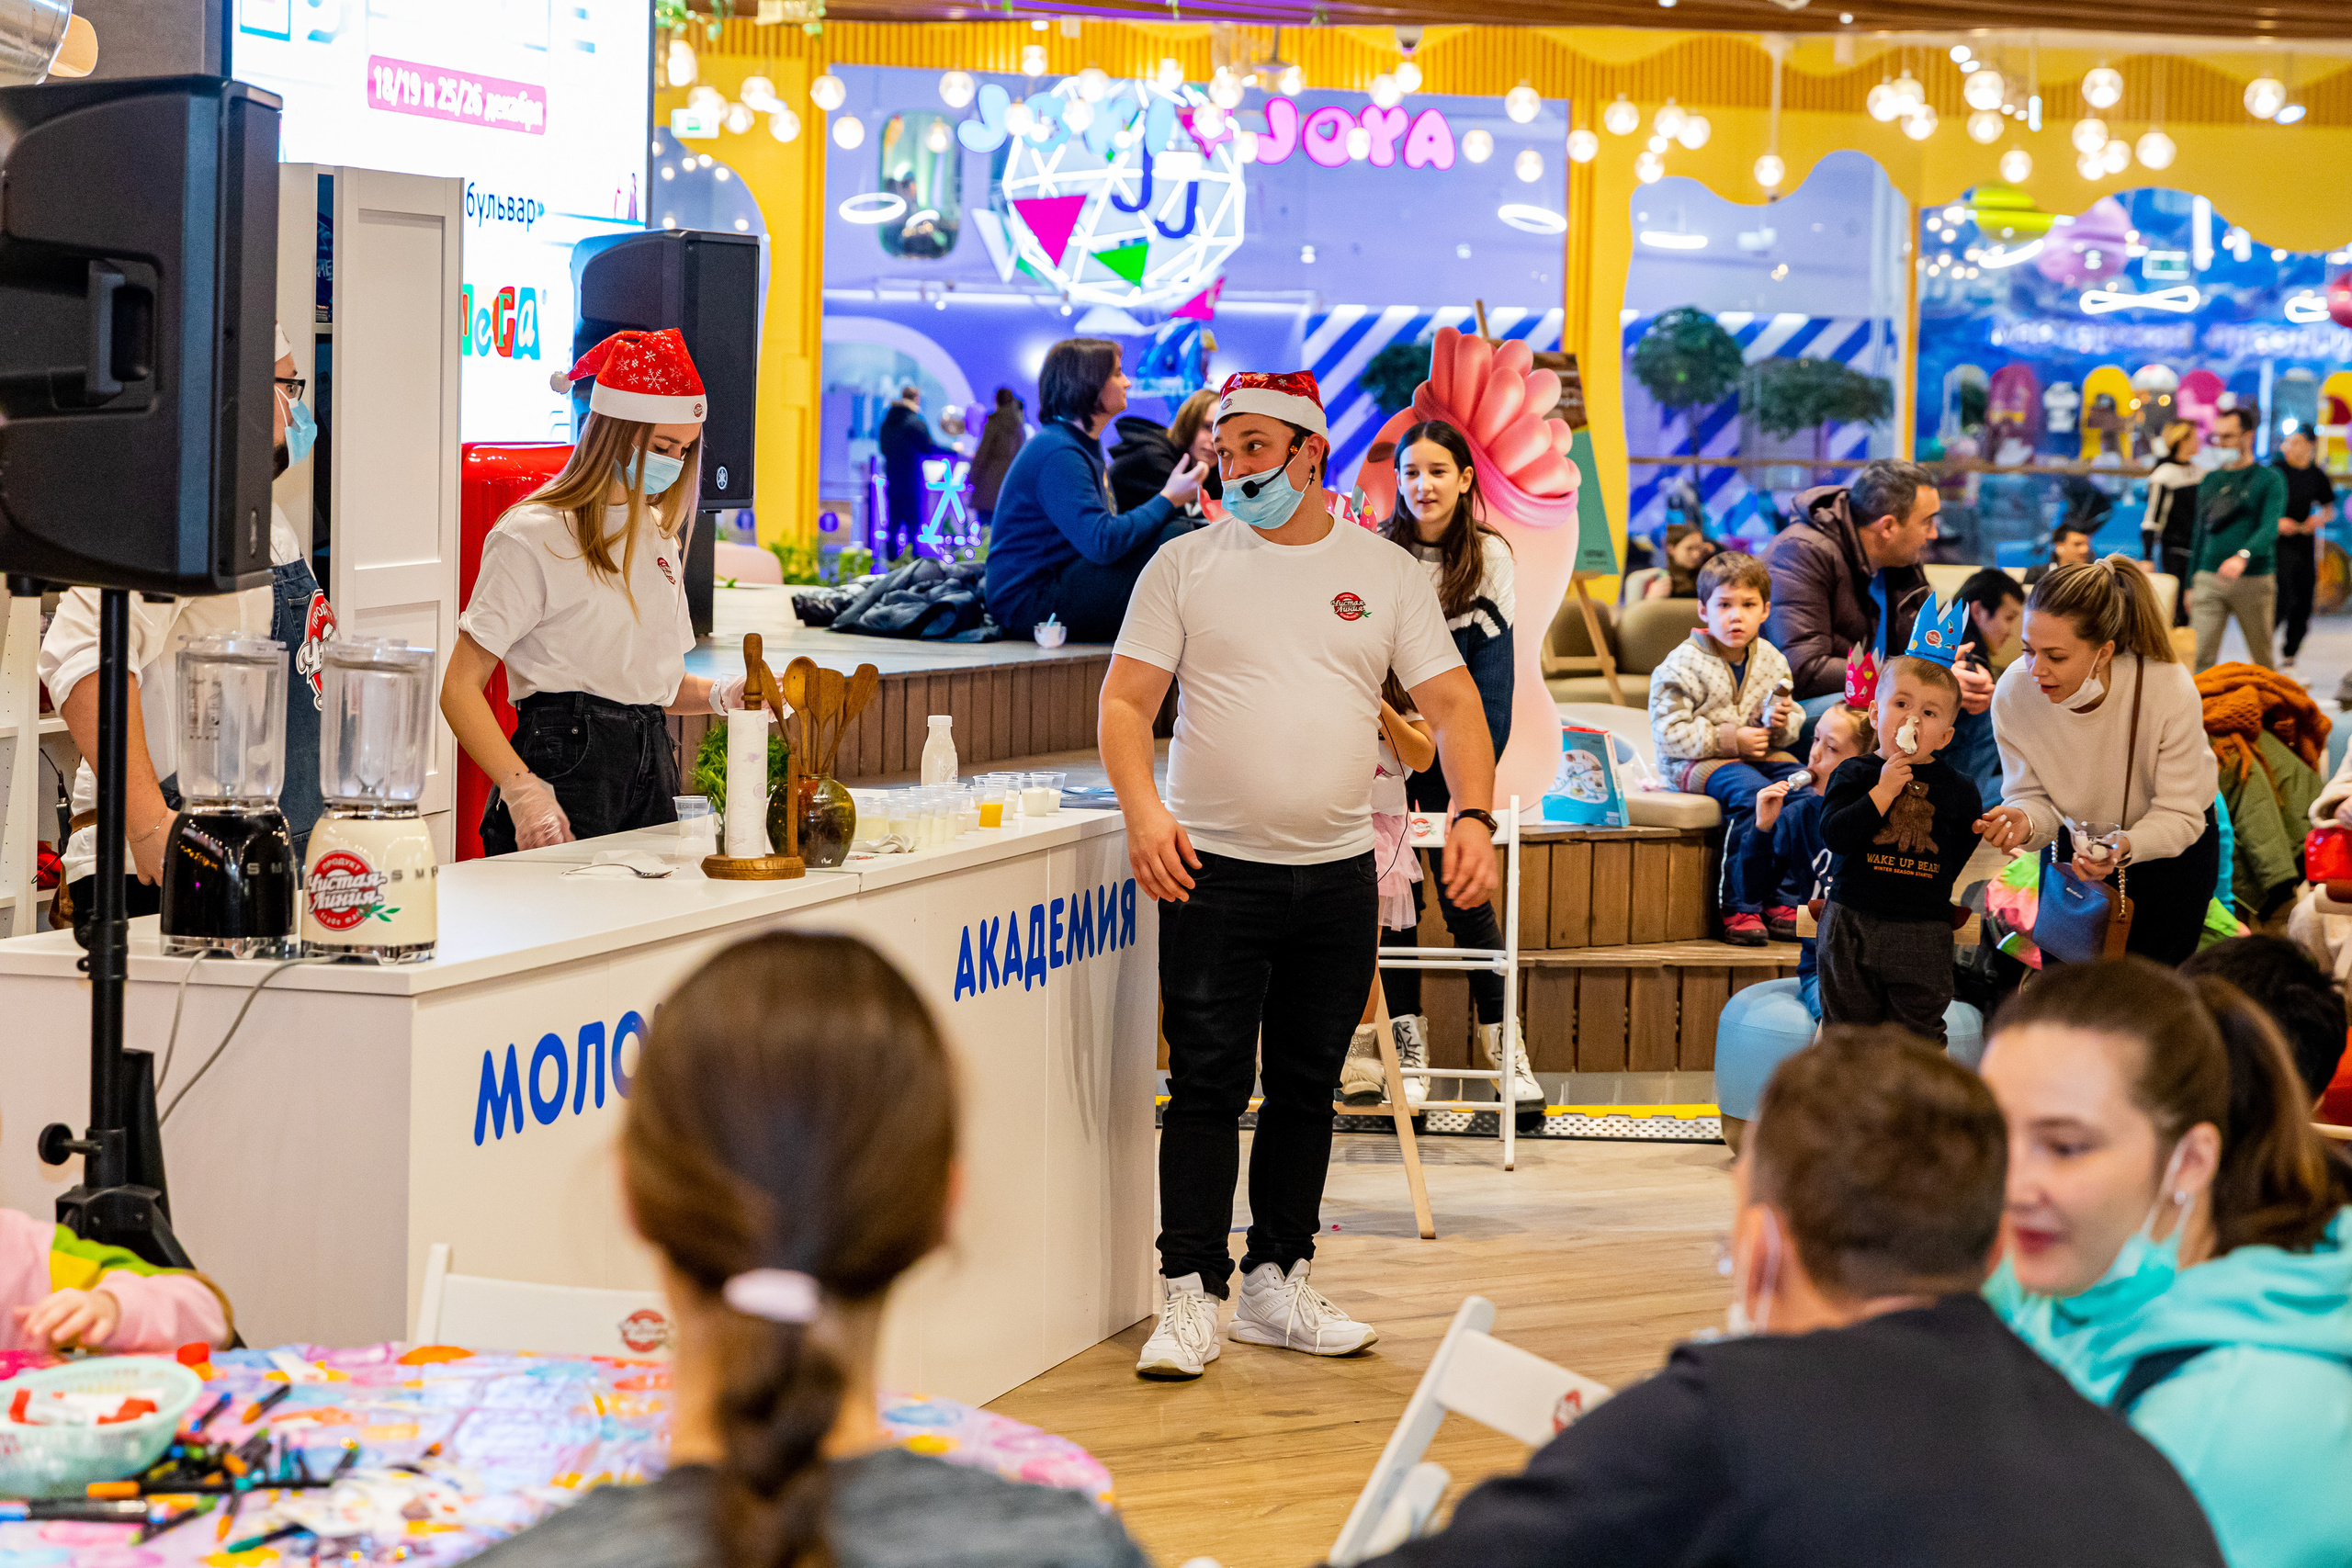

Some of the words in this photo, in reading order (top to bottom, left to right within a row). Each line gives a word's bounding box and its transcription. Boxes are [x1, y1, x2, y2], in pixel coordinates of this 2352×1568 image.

[373, 65, 421, 107] 18/19
[1253, 96, 1457, 172] JOYA
[1867, 852, 1895, 866] WAKE
[1899, 857, 1915, 868] UP
[1894, 868, 1915, 876] SEASON
[306, 872, 388, 894] Чистая
[309, 889, 384, 914] Линия
[474, 1010, 650, 1147] МОЛО
[954, 877, 1136, 1003] АКАДЕМИЯ
